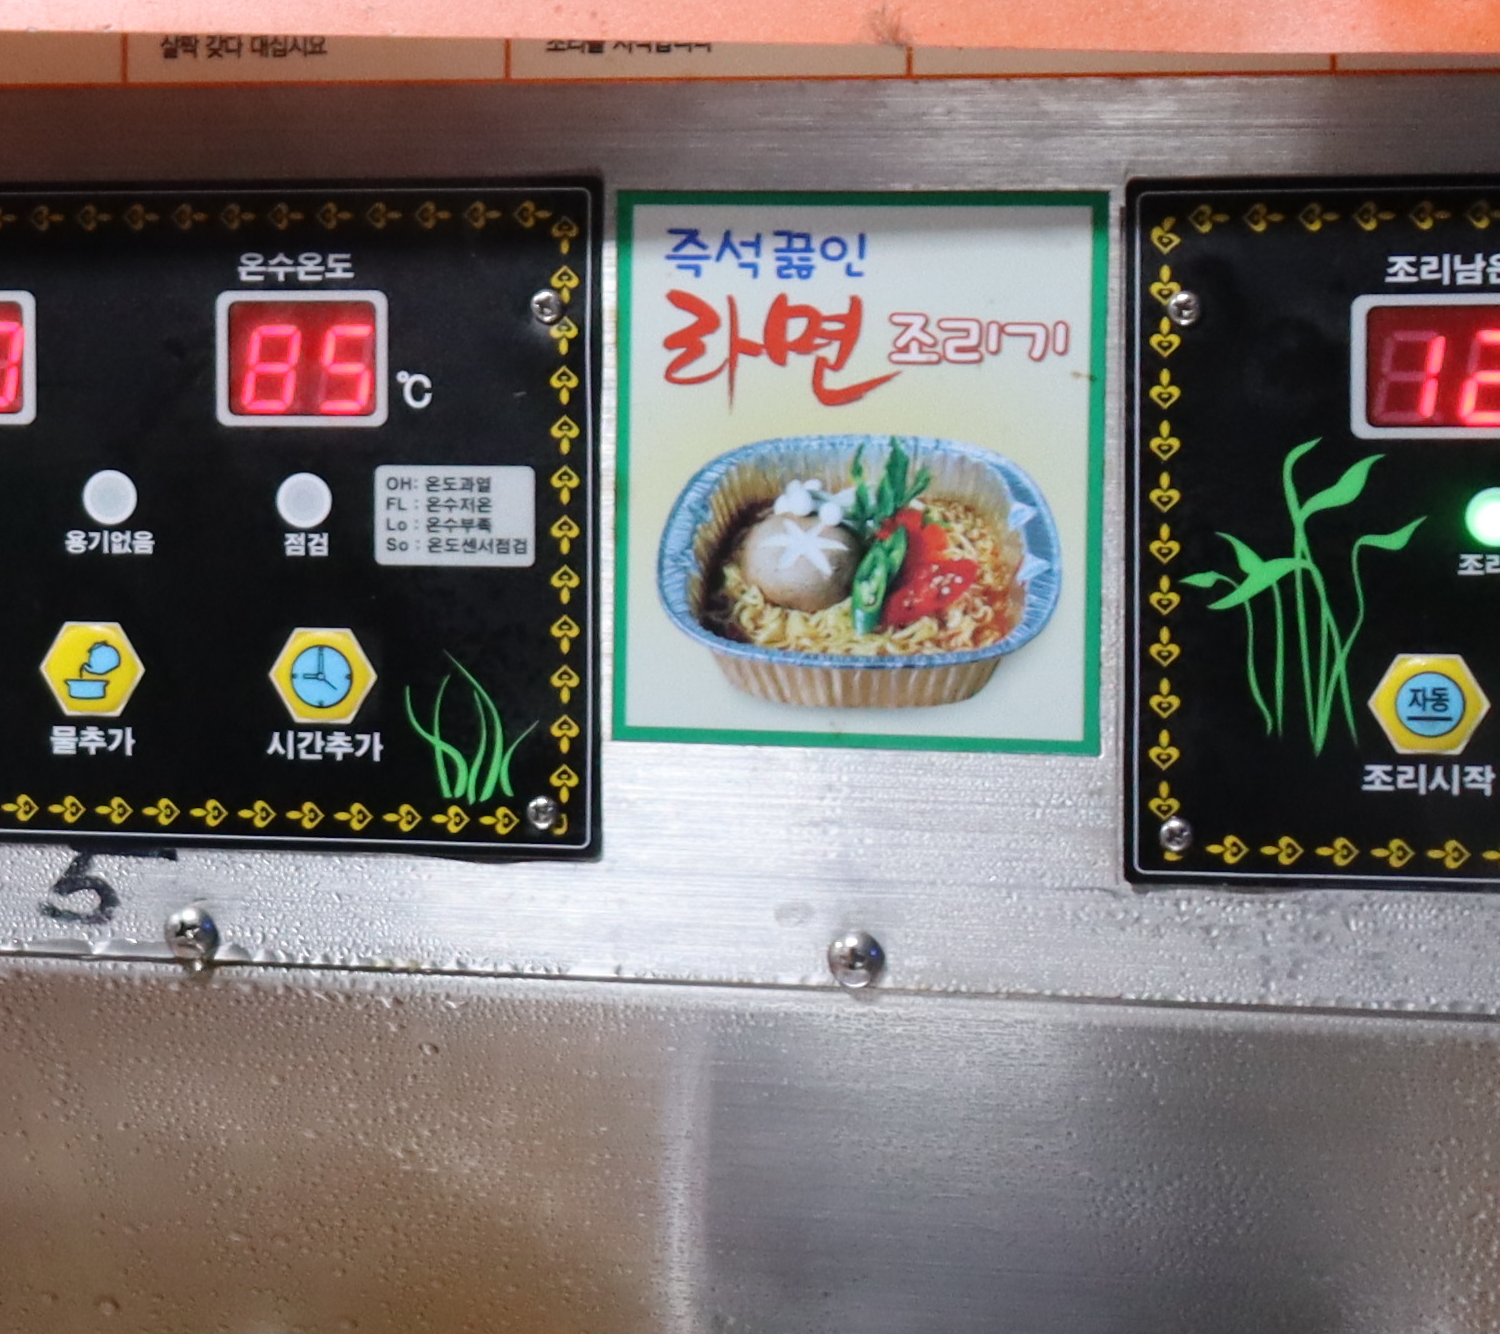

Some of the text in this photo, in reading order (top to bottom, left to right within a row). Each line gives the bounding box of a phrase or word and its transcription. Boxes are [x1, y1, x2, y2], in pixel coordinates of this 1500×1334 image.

[237, 252, 355, 282] 온수온도
[663, 229, 868, 281] 즉석 끓인
[663, 289, 1072, 411] 라면 조리기
[240, 321, 374, 415] 85
[425, 476, 491, 492] 온도과열
[426, 496, 491, 513] 온수저온
[426, 517, 491, 533] 온수부족
[64, 529, 156, 555] 용기없음
[283, 532, 329, 557] 점검
[428, 537, 528, 554] 온도센서점검
[1407, 685, 1452, 713] 자동
[49, 725, 136, 757] 물추가
[266, 730, 384, 762] 시간추가
[1361, 763, 1496, 797] 조리시작
